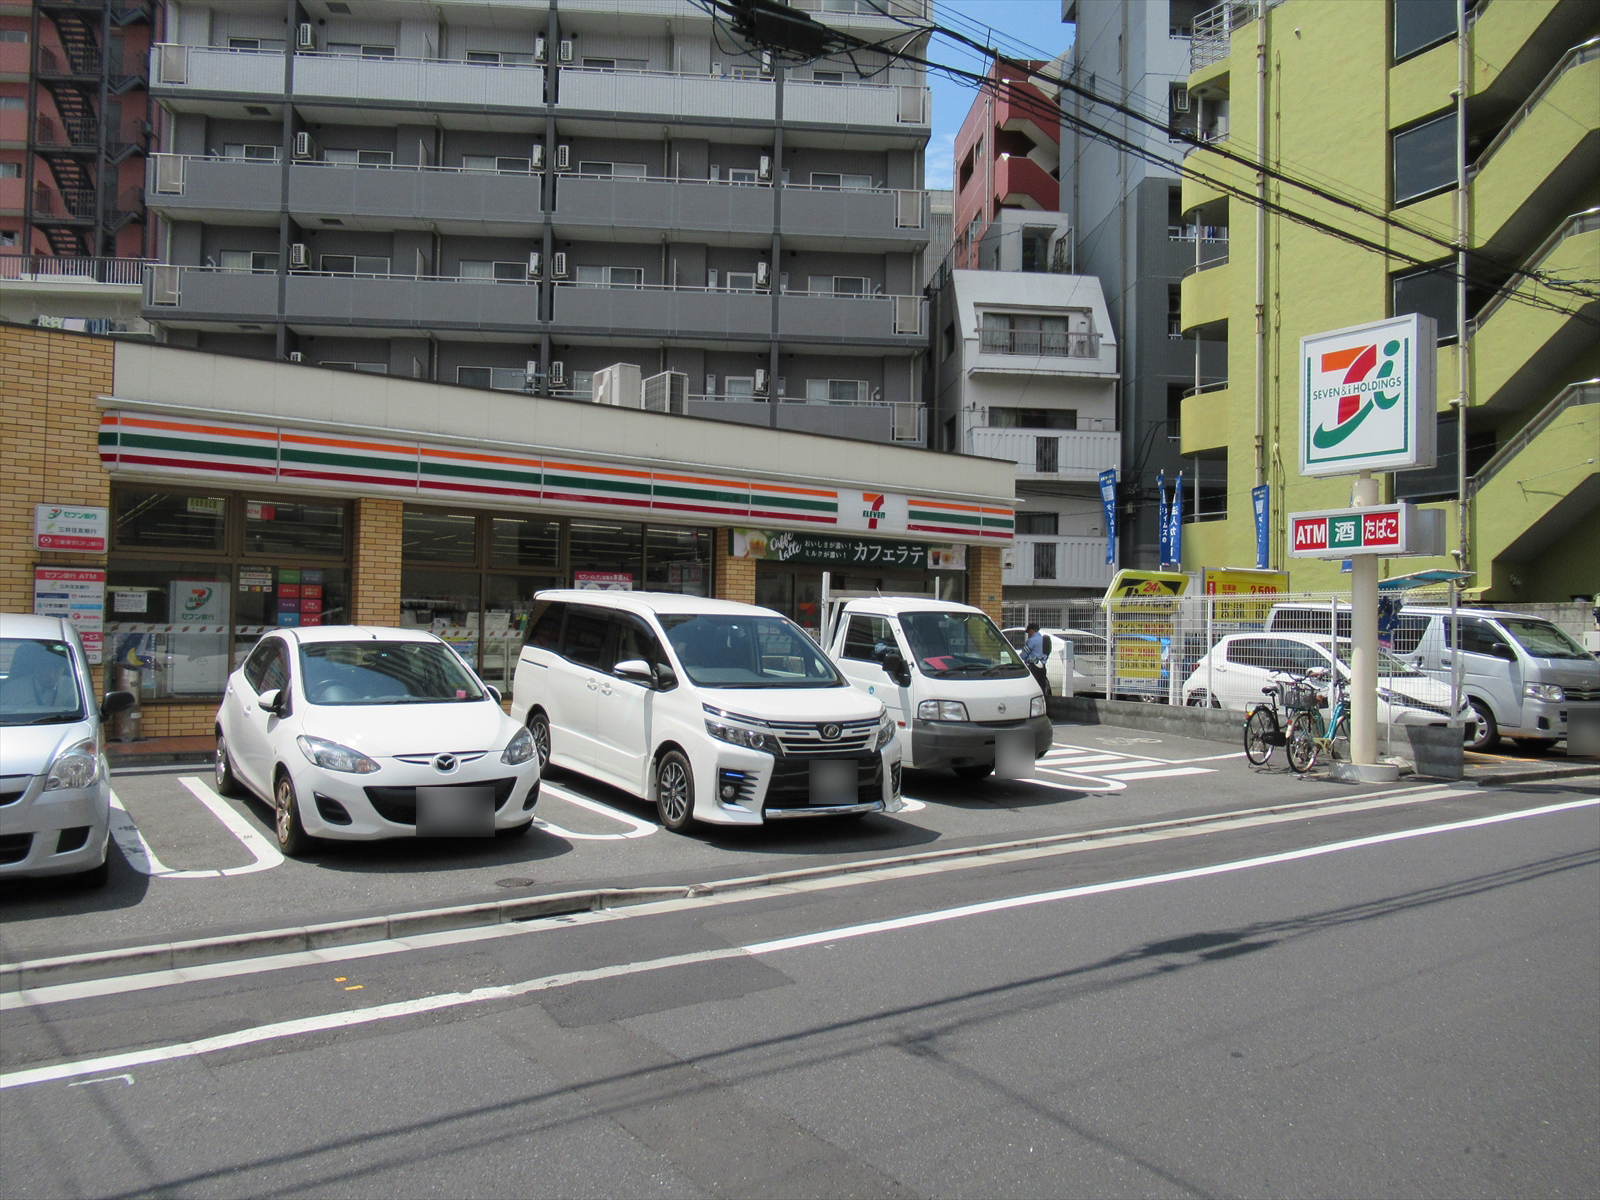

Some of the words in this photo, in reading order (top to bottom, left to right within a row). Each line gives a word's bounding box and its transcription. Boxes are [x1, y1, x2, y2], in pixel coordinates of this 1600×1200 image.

[1352, 376, 1402, 394] HOLDINGS
[64, 511, 97, 519] セブン銀行
[1296, 523, 1326, 545] ATM
[1334, 521, 1356, 543] 酒
[1364, 518, 1397, 540] たばこ
[779, 541, 802, 561] Latte
[853, 542, 924, 565] カフェラテ
[44, 571, 76, 579] セブン銀行
